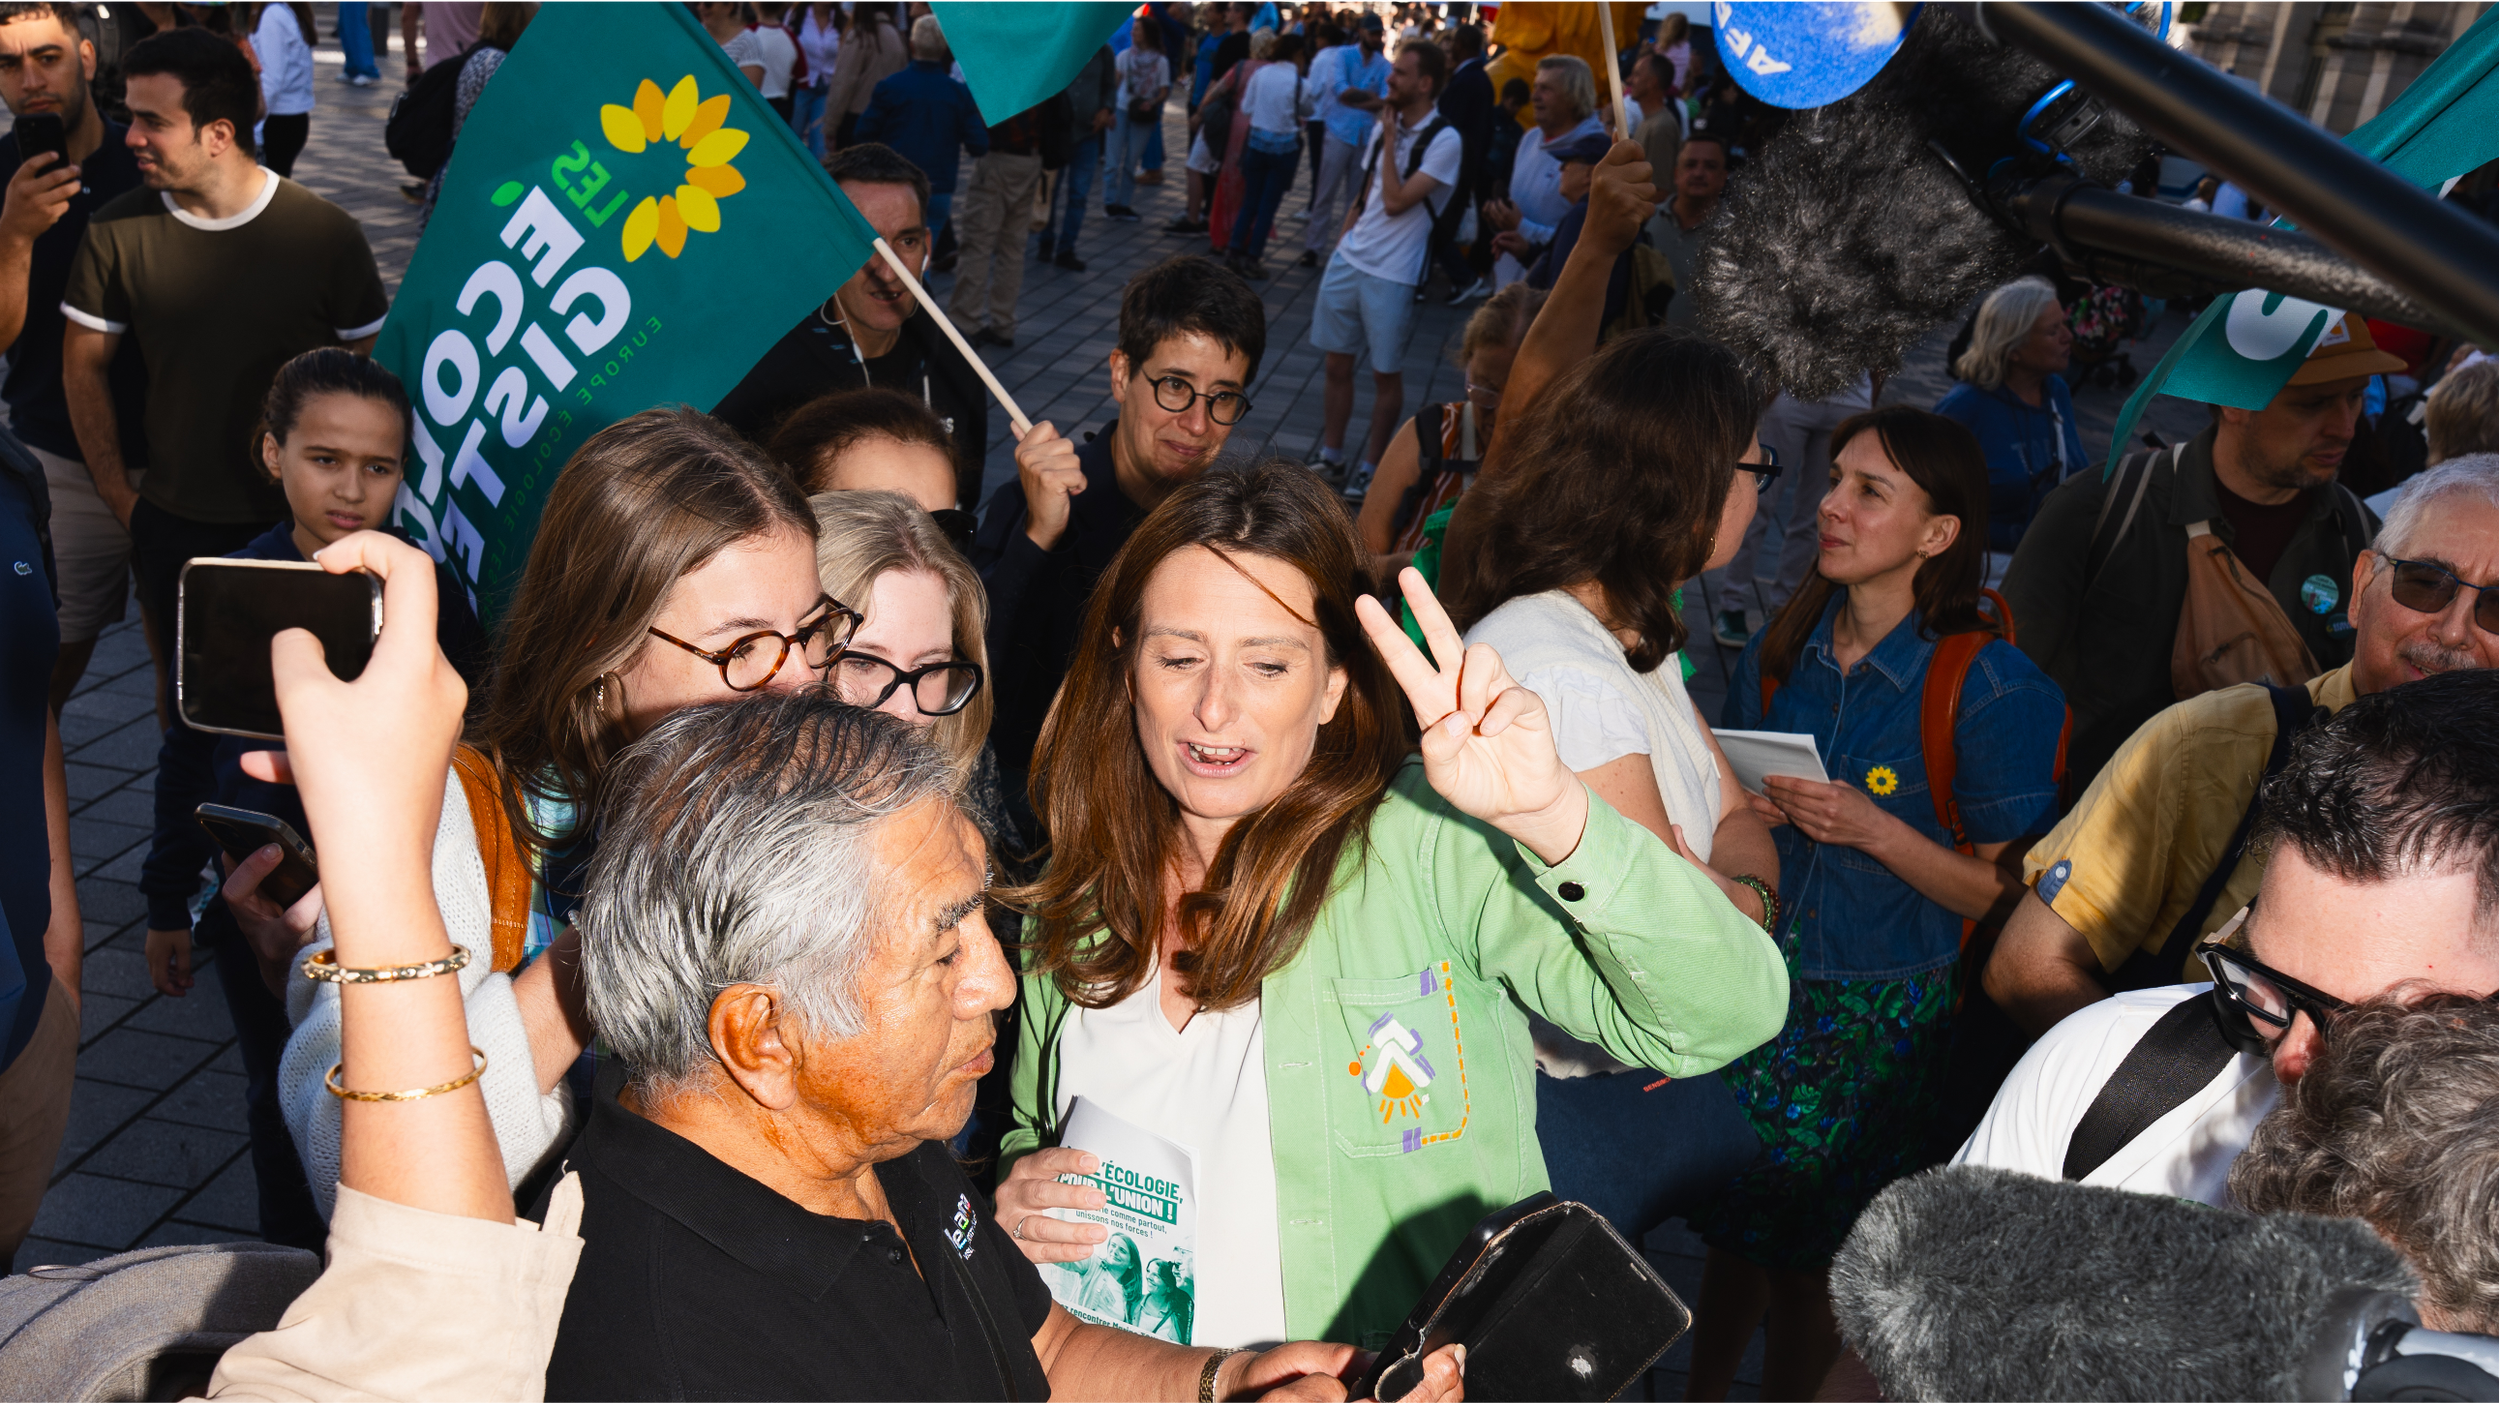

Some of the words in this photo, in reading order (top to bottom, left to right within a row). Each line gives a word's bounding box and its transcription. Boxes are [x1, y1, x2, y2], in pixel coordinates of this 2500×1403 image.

[1093, 1160, 1183, 1204] 'ÉCOLOGIE,
[1101, 1182, 1164, 1218] L'UNION
[1167, 1203, 1174, 1221] !
[1076, 1210, 1109, 1225] unissons
[1111, 1219, 1124, 1229] nos
[1125, 1222, 1149, 1237] forces
[1110, 1209, 1136, 1223] comme
[1138, 1218, 1167, 1234] partout,
[1070, 1307, 1111, 1327] rencontrer
